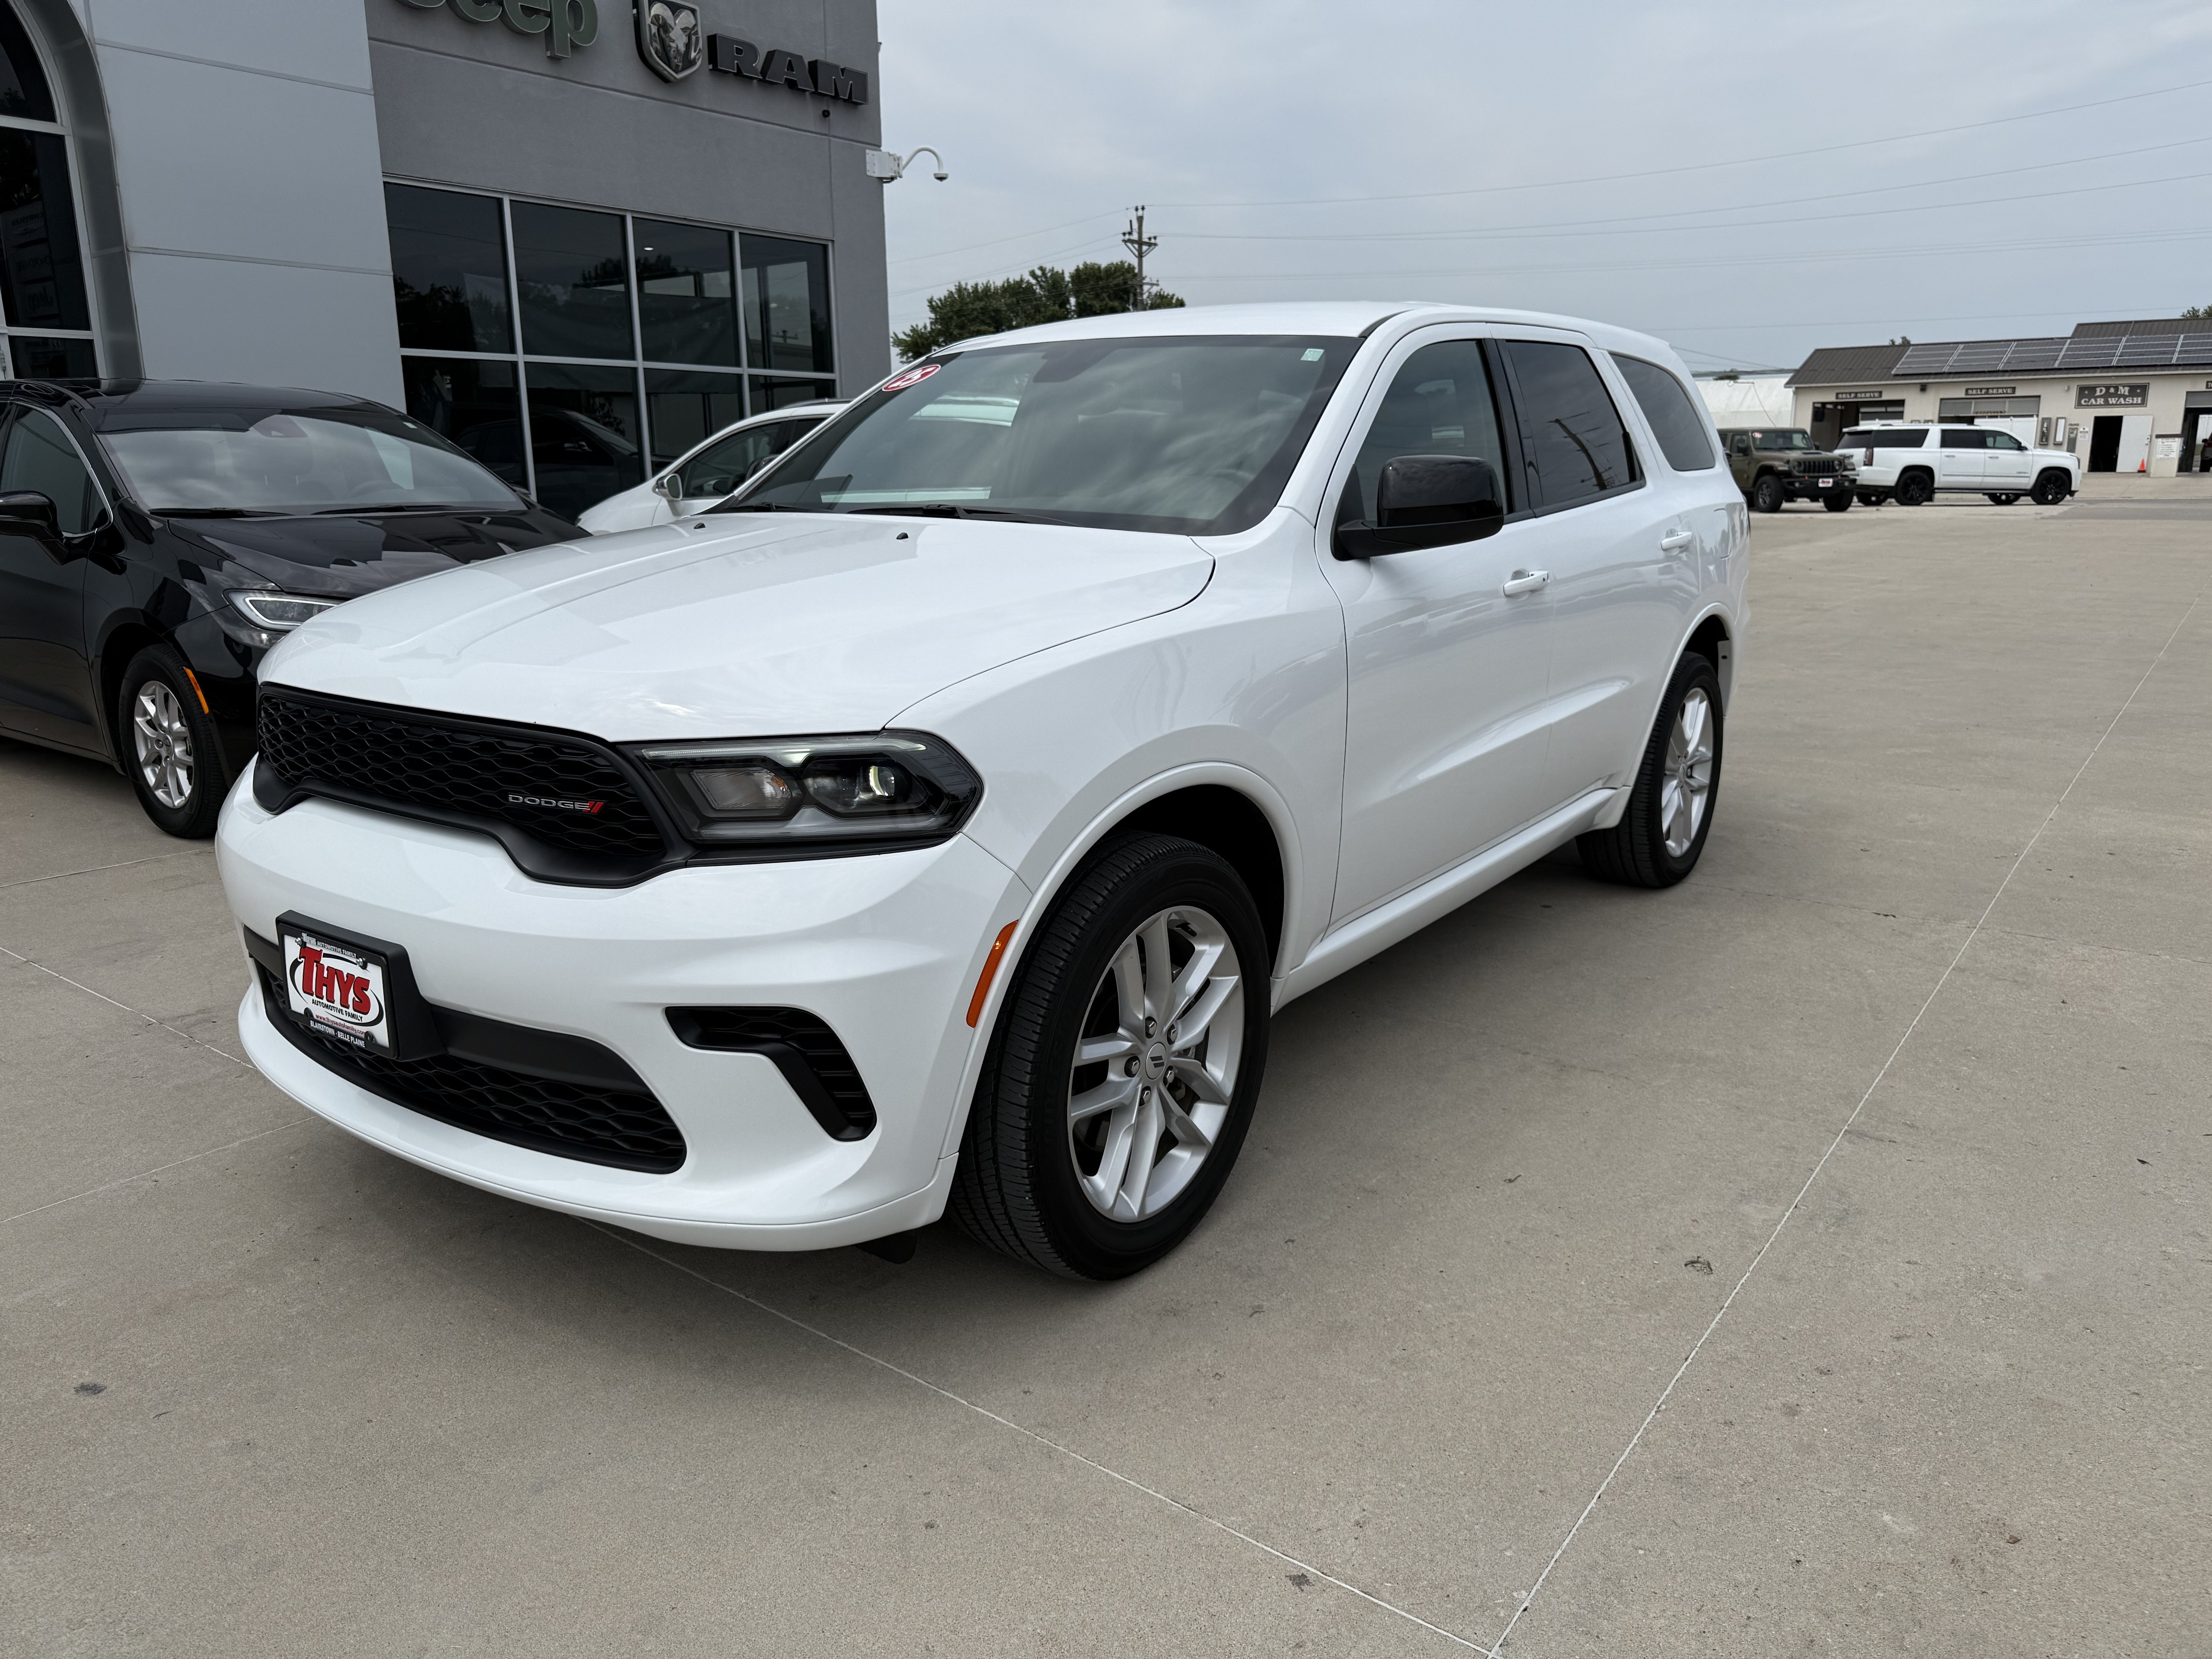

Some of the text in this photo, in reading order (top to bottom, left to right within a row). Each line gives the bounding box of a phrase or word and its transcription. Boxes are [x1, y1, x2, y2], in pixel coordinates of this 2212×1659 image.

[707, 33, 868, 105] RAM
[2095, 387, 2106, 396] D
[2118, 386, 2130, 395] M
[508, 794, 591, 810] DODGE
[317, 941, 342, 953] AUTOMOTIVE
[342, 950, 357, 958] FAMILY
[299, 946, 371, 1015] THYS
[312, 999, 363, 1022] AUTOMOTIVE FAMILY
[310, 1020, 365, 1048] BLAIRSTOWN BELLE PLAINE
